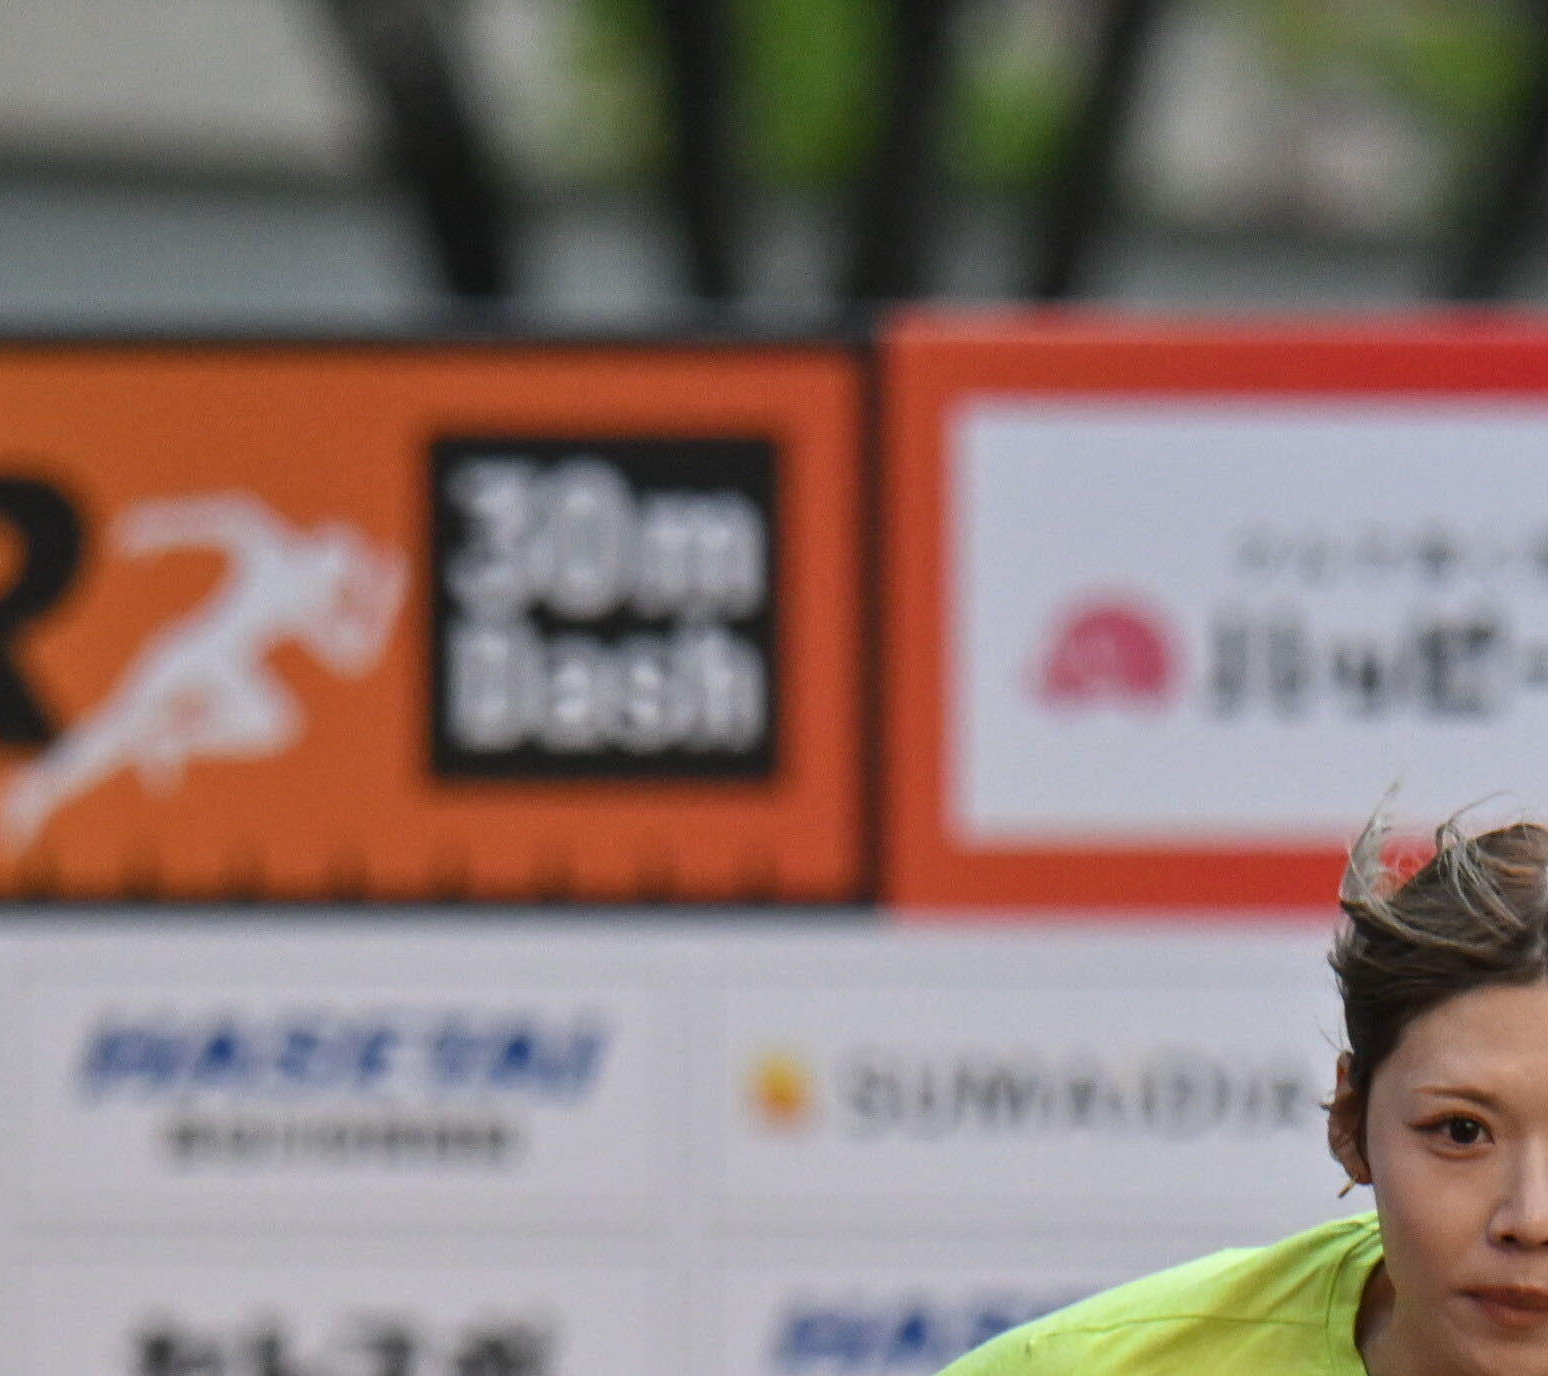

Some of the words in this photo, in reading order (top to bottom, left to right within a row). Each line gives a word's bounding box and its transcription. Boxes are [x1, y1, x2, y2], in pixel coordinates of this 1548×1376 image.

[448, 456, 764, 615] 30m
[450, 625, 764, 748] Dash
[77, 1012, 606, 1097] HASETAI
